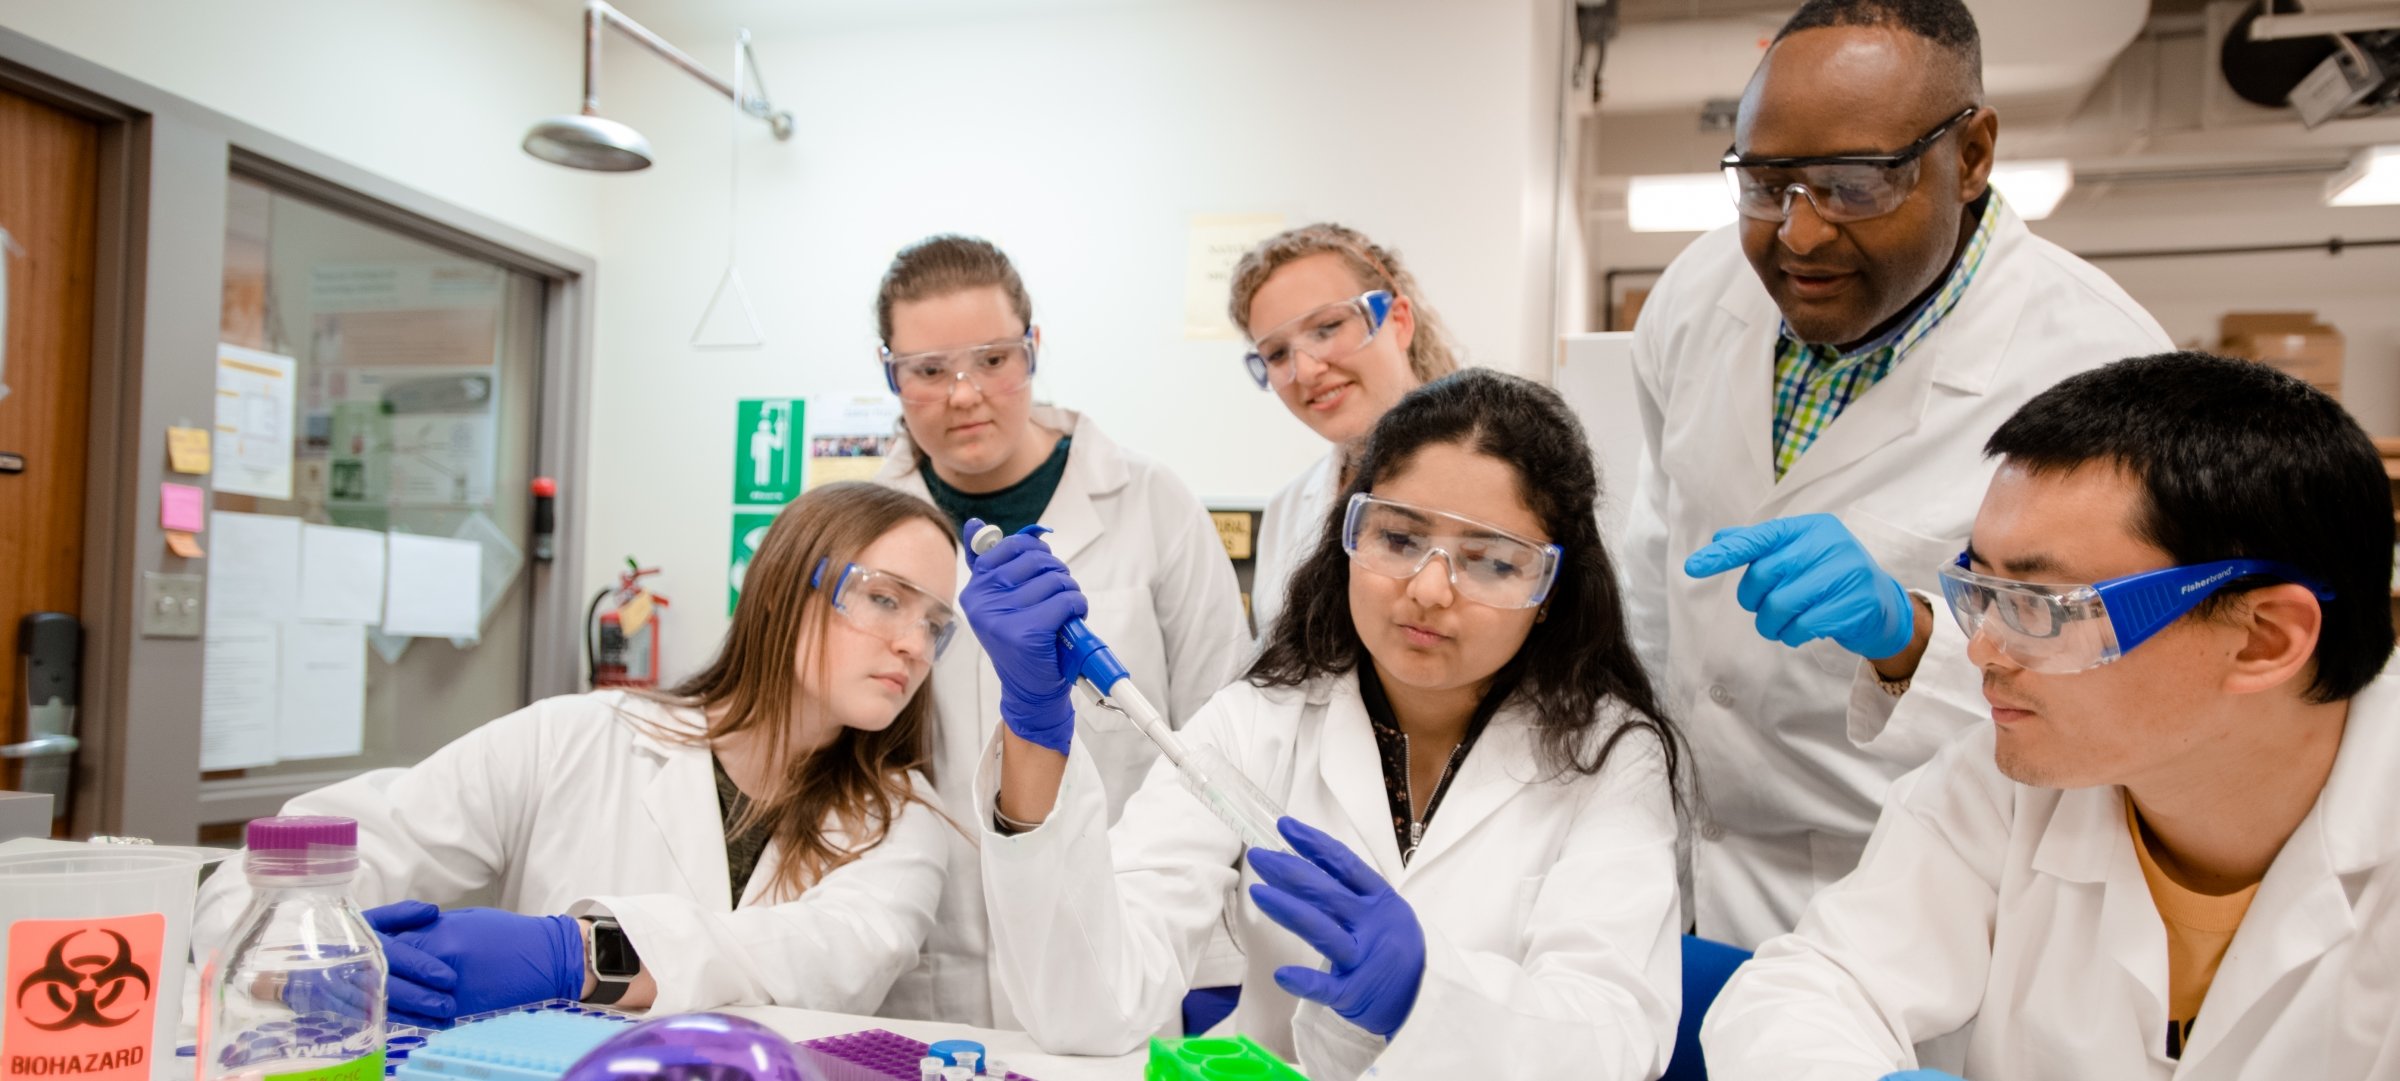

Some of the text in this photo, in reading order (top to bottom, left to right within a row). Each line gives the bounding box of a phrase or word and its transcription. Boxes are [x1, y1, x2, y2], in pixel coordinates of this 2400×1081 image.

[2181, 567, 2233, 595] Fisherbrand
[11, 1045, 144, 1075] BIOHAZARD
[285, 1042, 342, 1059] VWR
